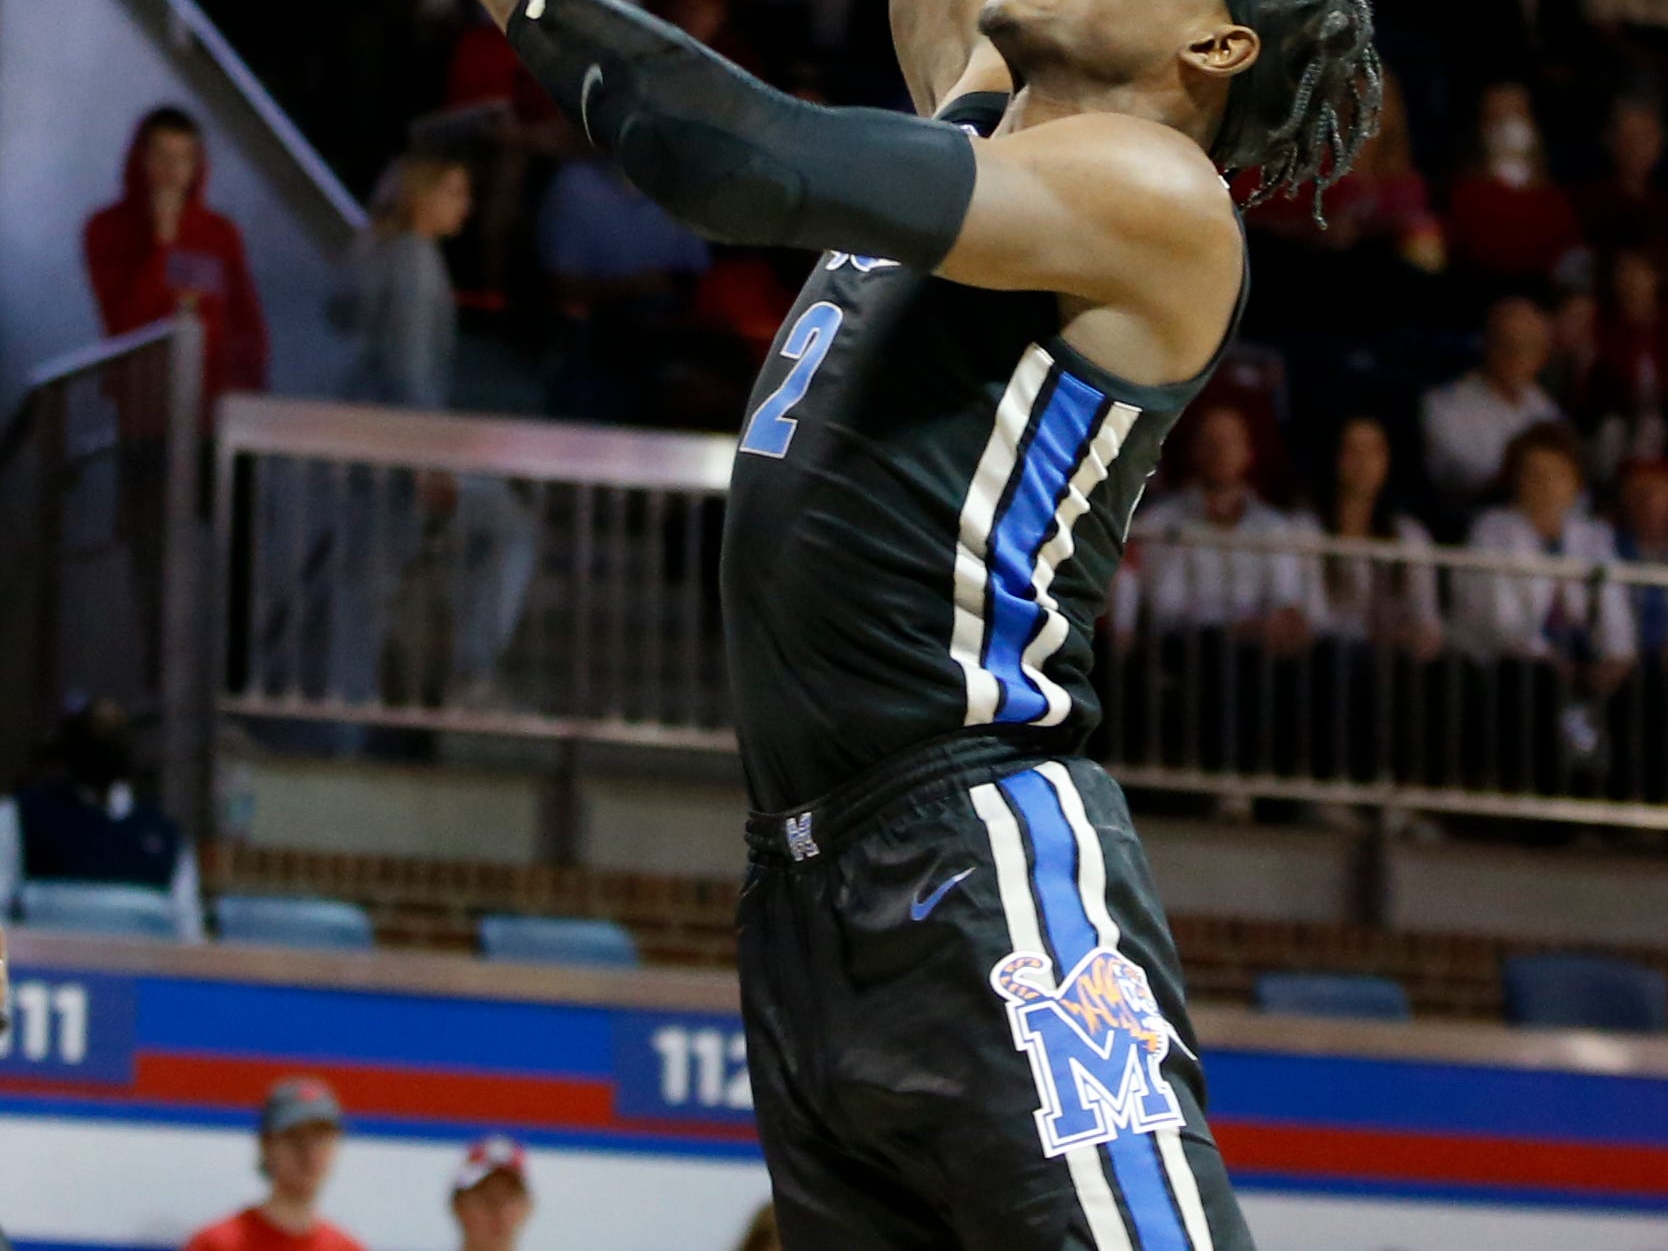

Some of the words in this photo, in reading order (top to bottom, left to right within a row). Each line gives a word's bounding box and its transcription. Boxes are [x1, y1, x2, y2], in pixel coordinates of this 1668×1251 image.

[740, 301, 843, 459] 2
[0, 984, 87, 1064] 11
[1004, 998, 1186, 1158] M
